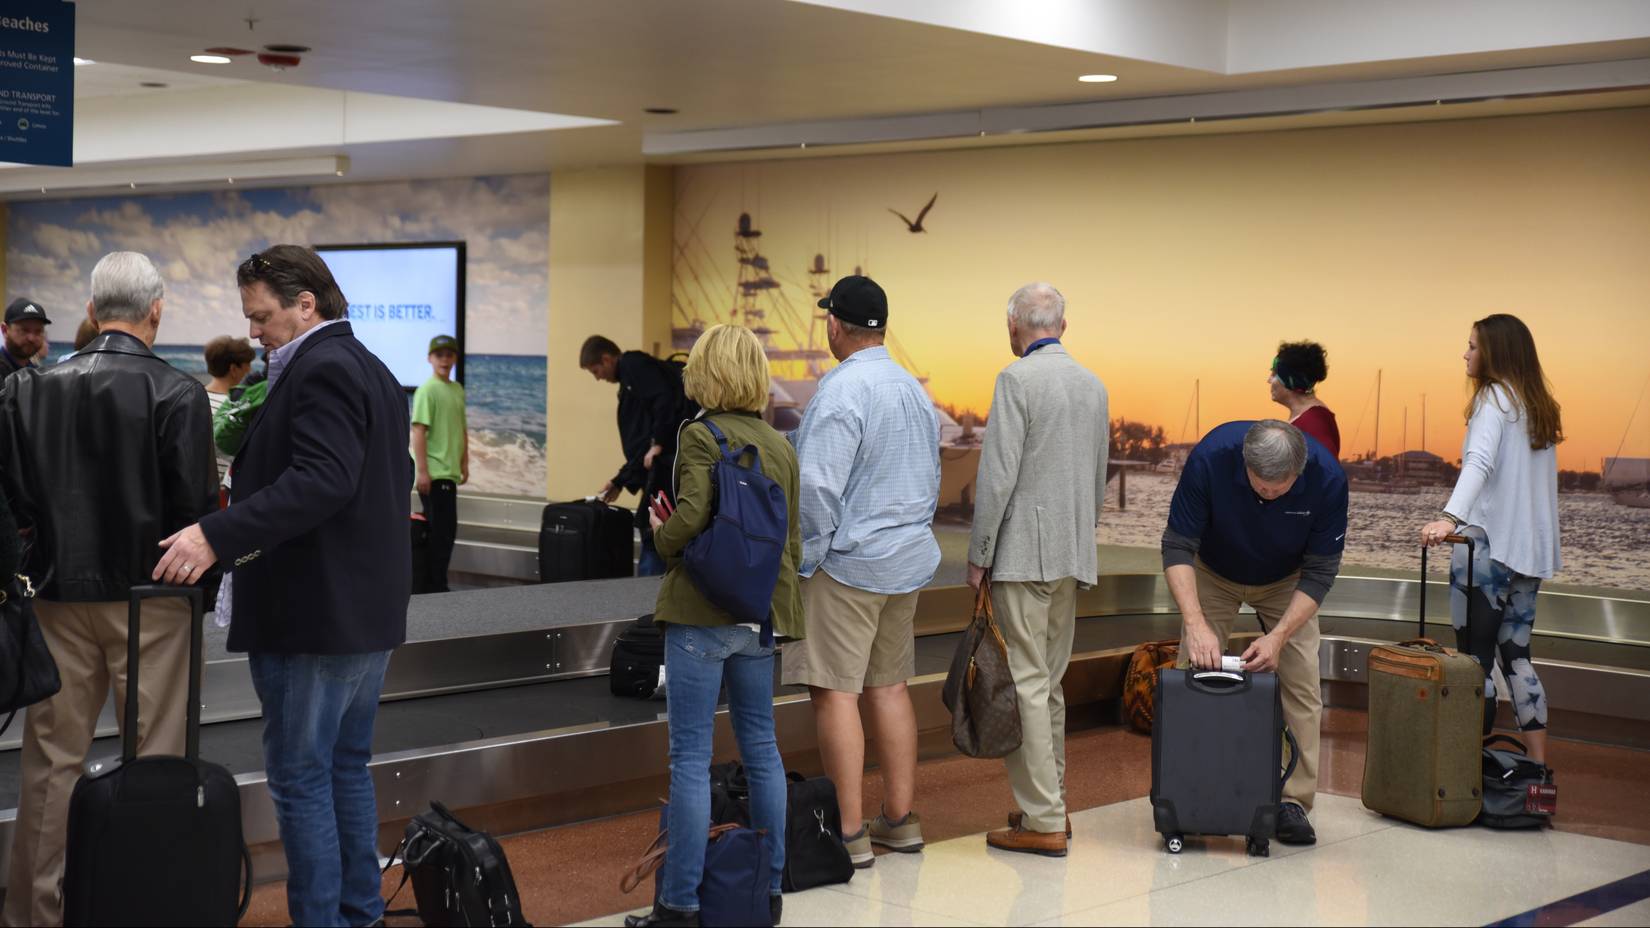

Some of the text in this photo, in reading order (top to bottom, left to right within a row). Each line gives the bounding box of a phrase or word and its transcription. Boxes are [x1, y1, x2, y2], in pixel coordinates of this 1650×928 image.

[0, 16, 49, 33] eaches
[12, 91, 57, 103] TRANSPORT
[346, 303, 436, 319] EST IS BETTER.
